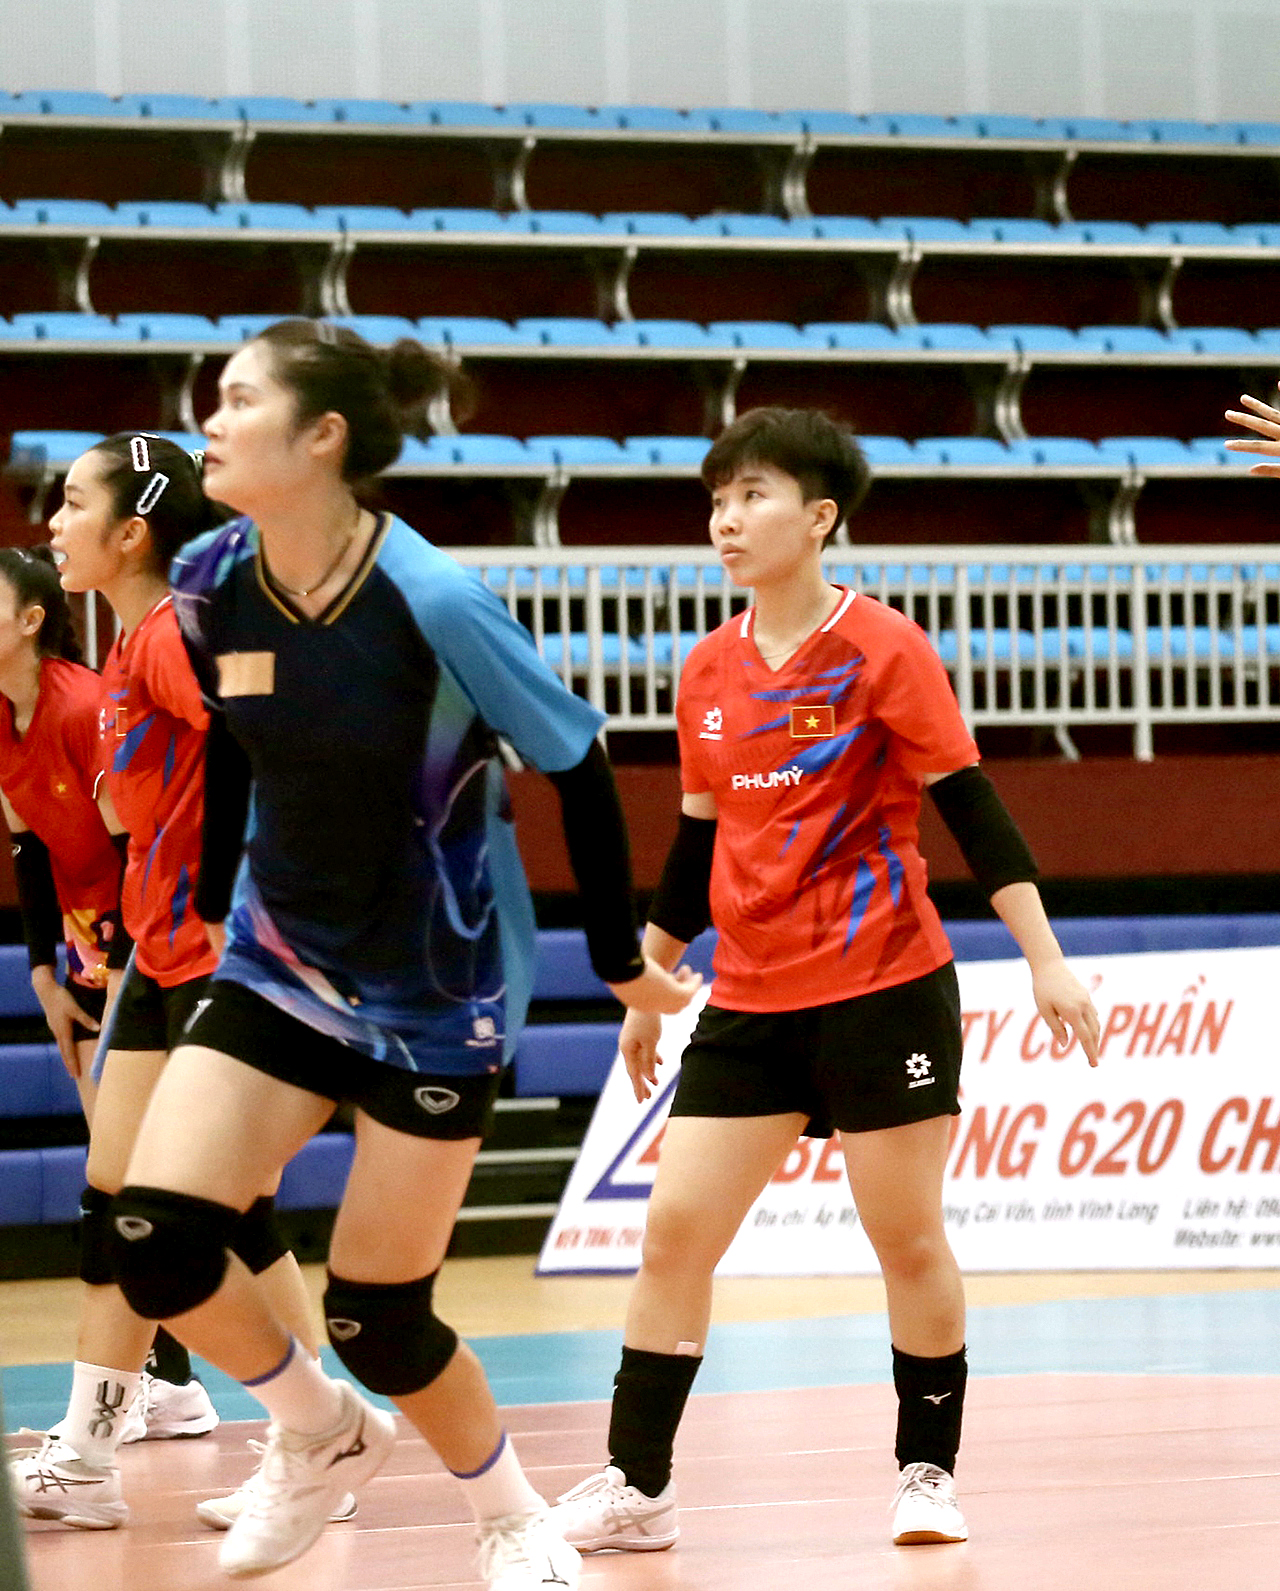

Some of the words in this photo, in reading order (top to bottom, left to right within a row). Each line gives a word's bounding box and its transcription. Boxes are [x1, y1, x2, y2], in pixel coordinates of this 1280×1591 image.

[1099, 973, 1234, 1060] PHẦN
[1057, 1097, 1185, 1178] 620
[1117, 1197, 1160, 1226] Long
